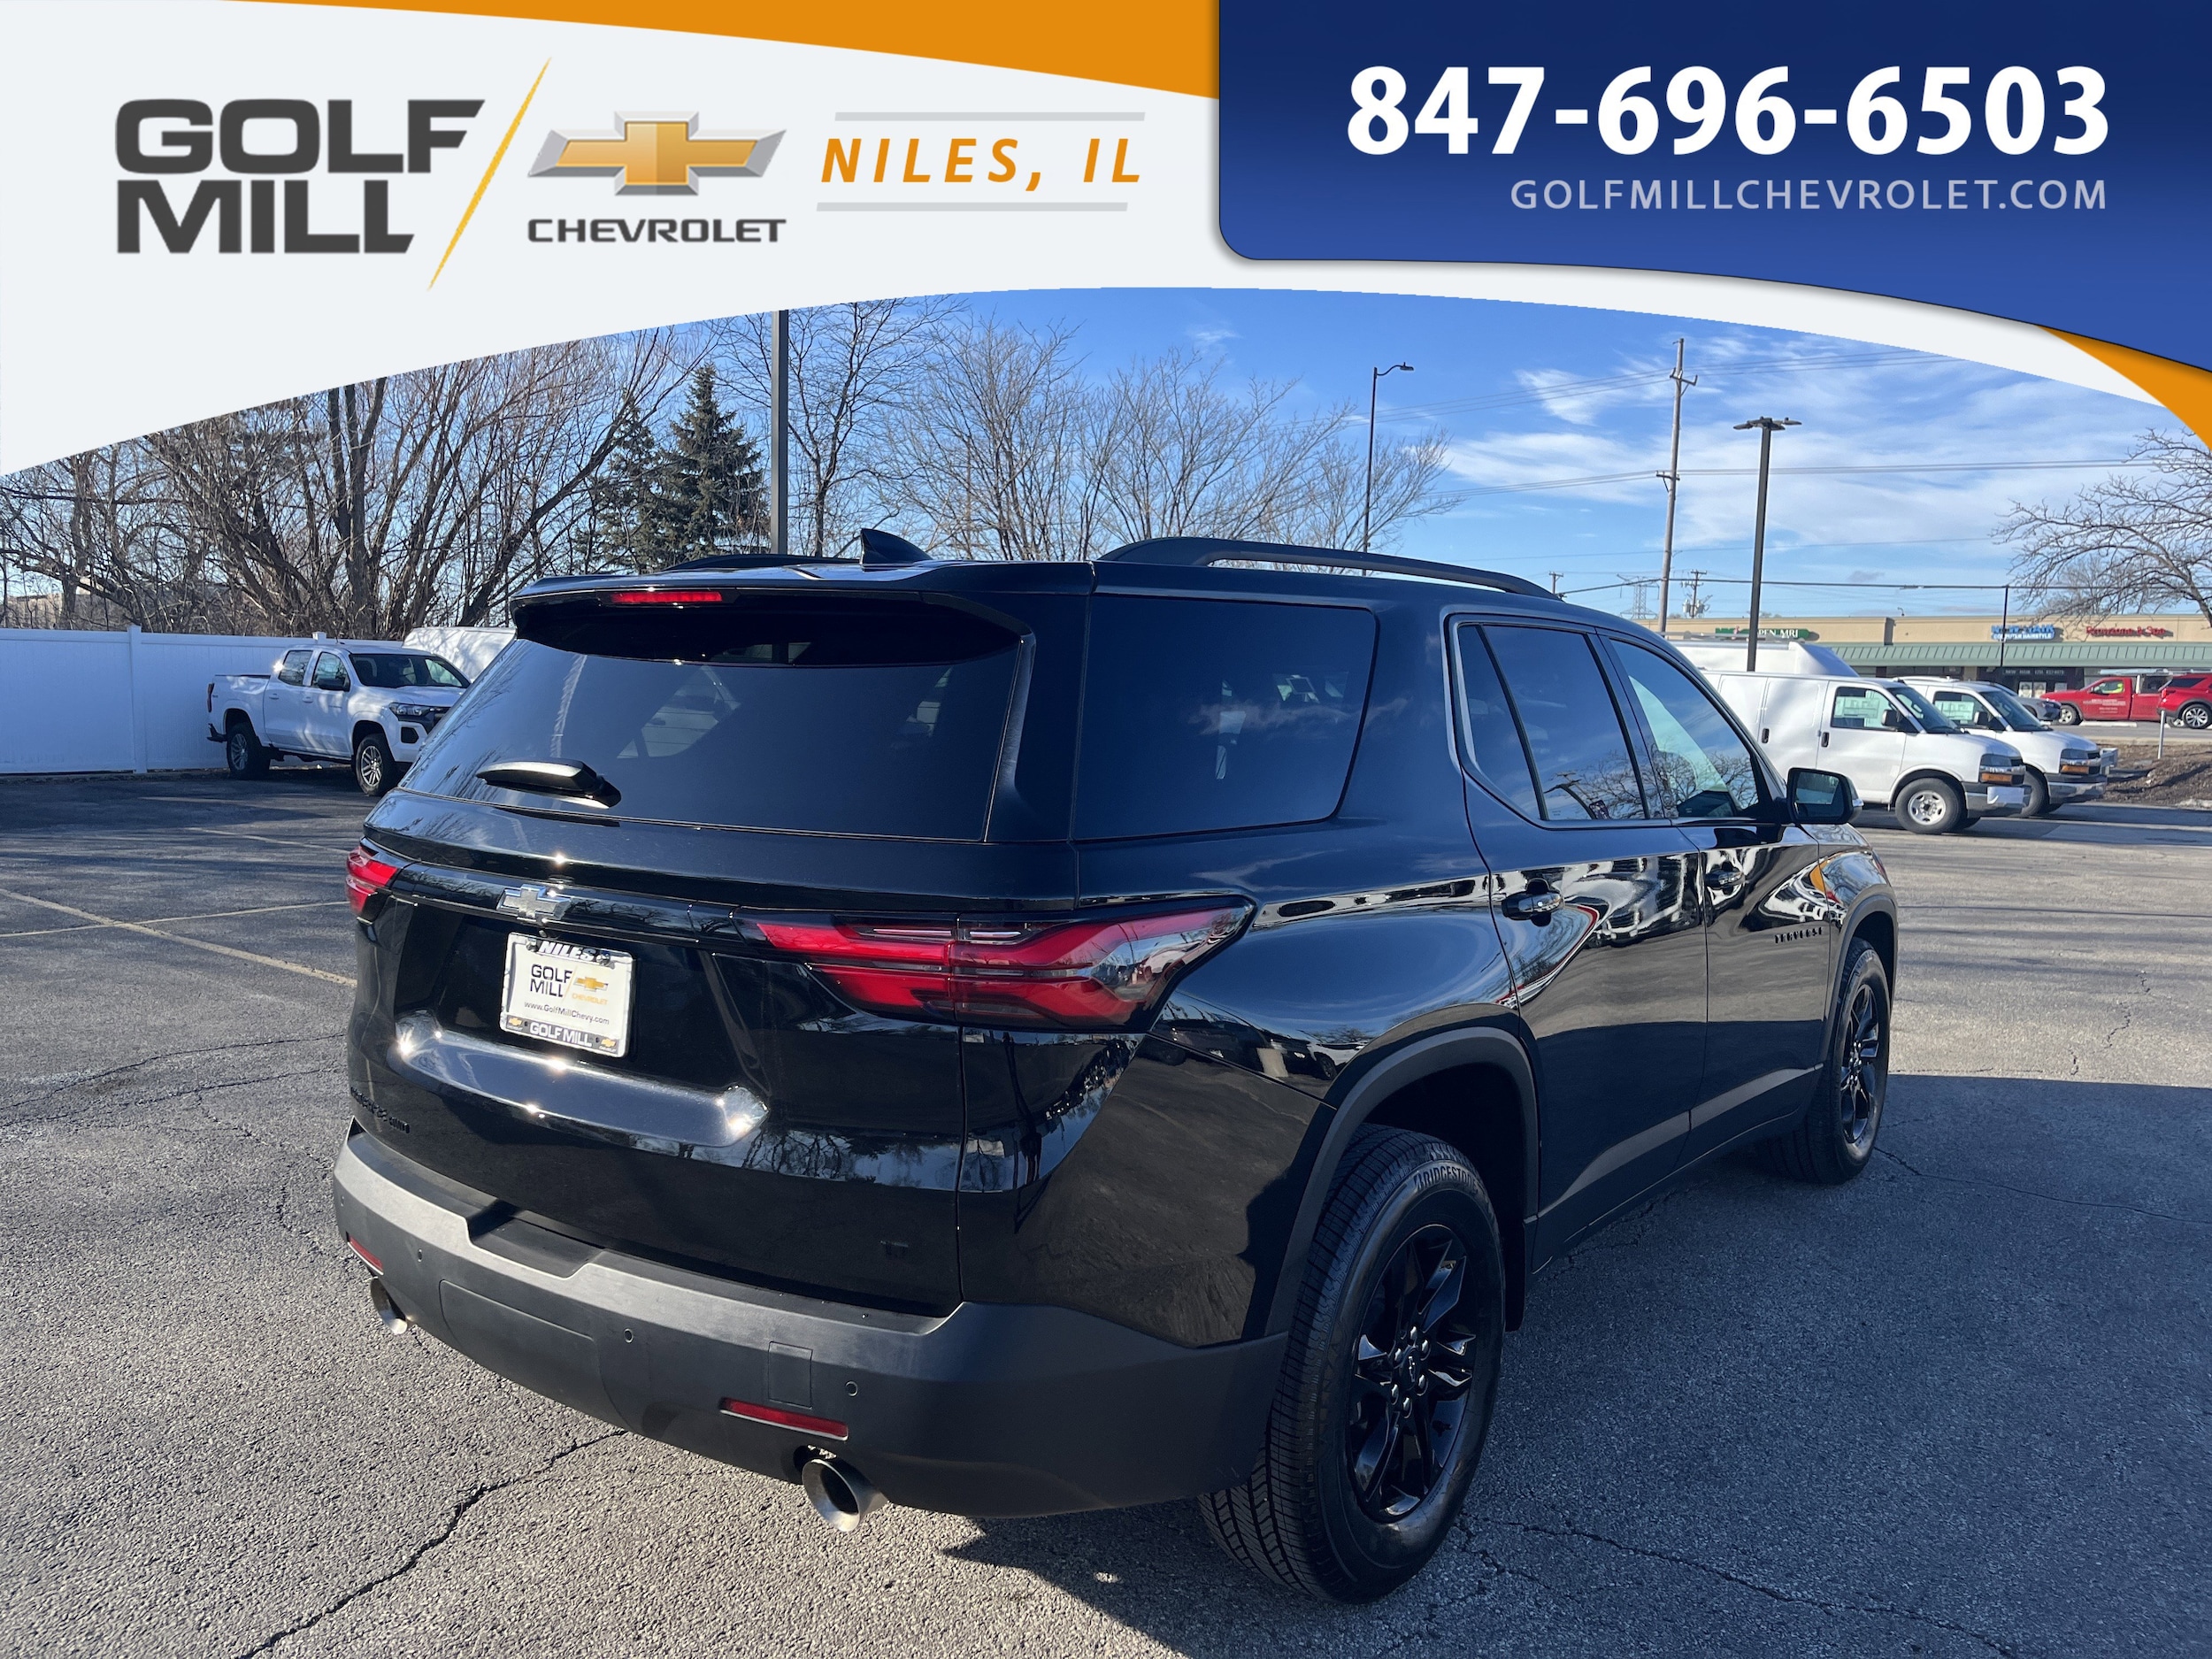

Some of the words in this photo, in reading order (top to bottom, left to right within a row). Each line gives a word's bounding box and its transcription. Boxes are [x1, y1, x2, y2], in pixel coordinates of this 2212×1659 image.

[1779, 629, 1799, 638] MRI
[538, 941, 597, 962] NILES
[531, 964, 573, 984] GOLF
[530, 979, 564, 998] MILL
[572, 993, 609, 1006] CHEVROLET
[524, 1002, 610, 1025] www.GolfMillChevy.com
[530, 1021, 563, 1040] GOLF
[562, 1029, 593, 1048] MILL
